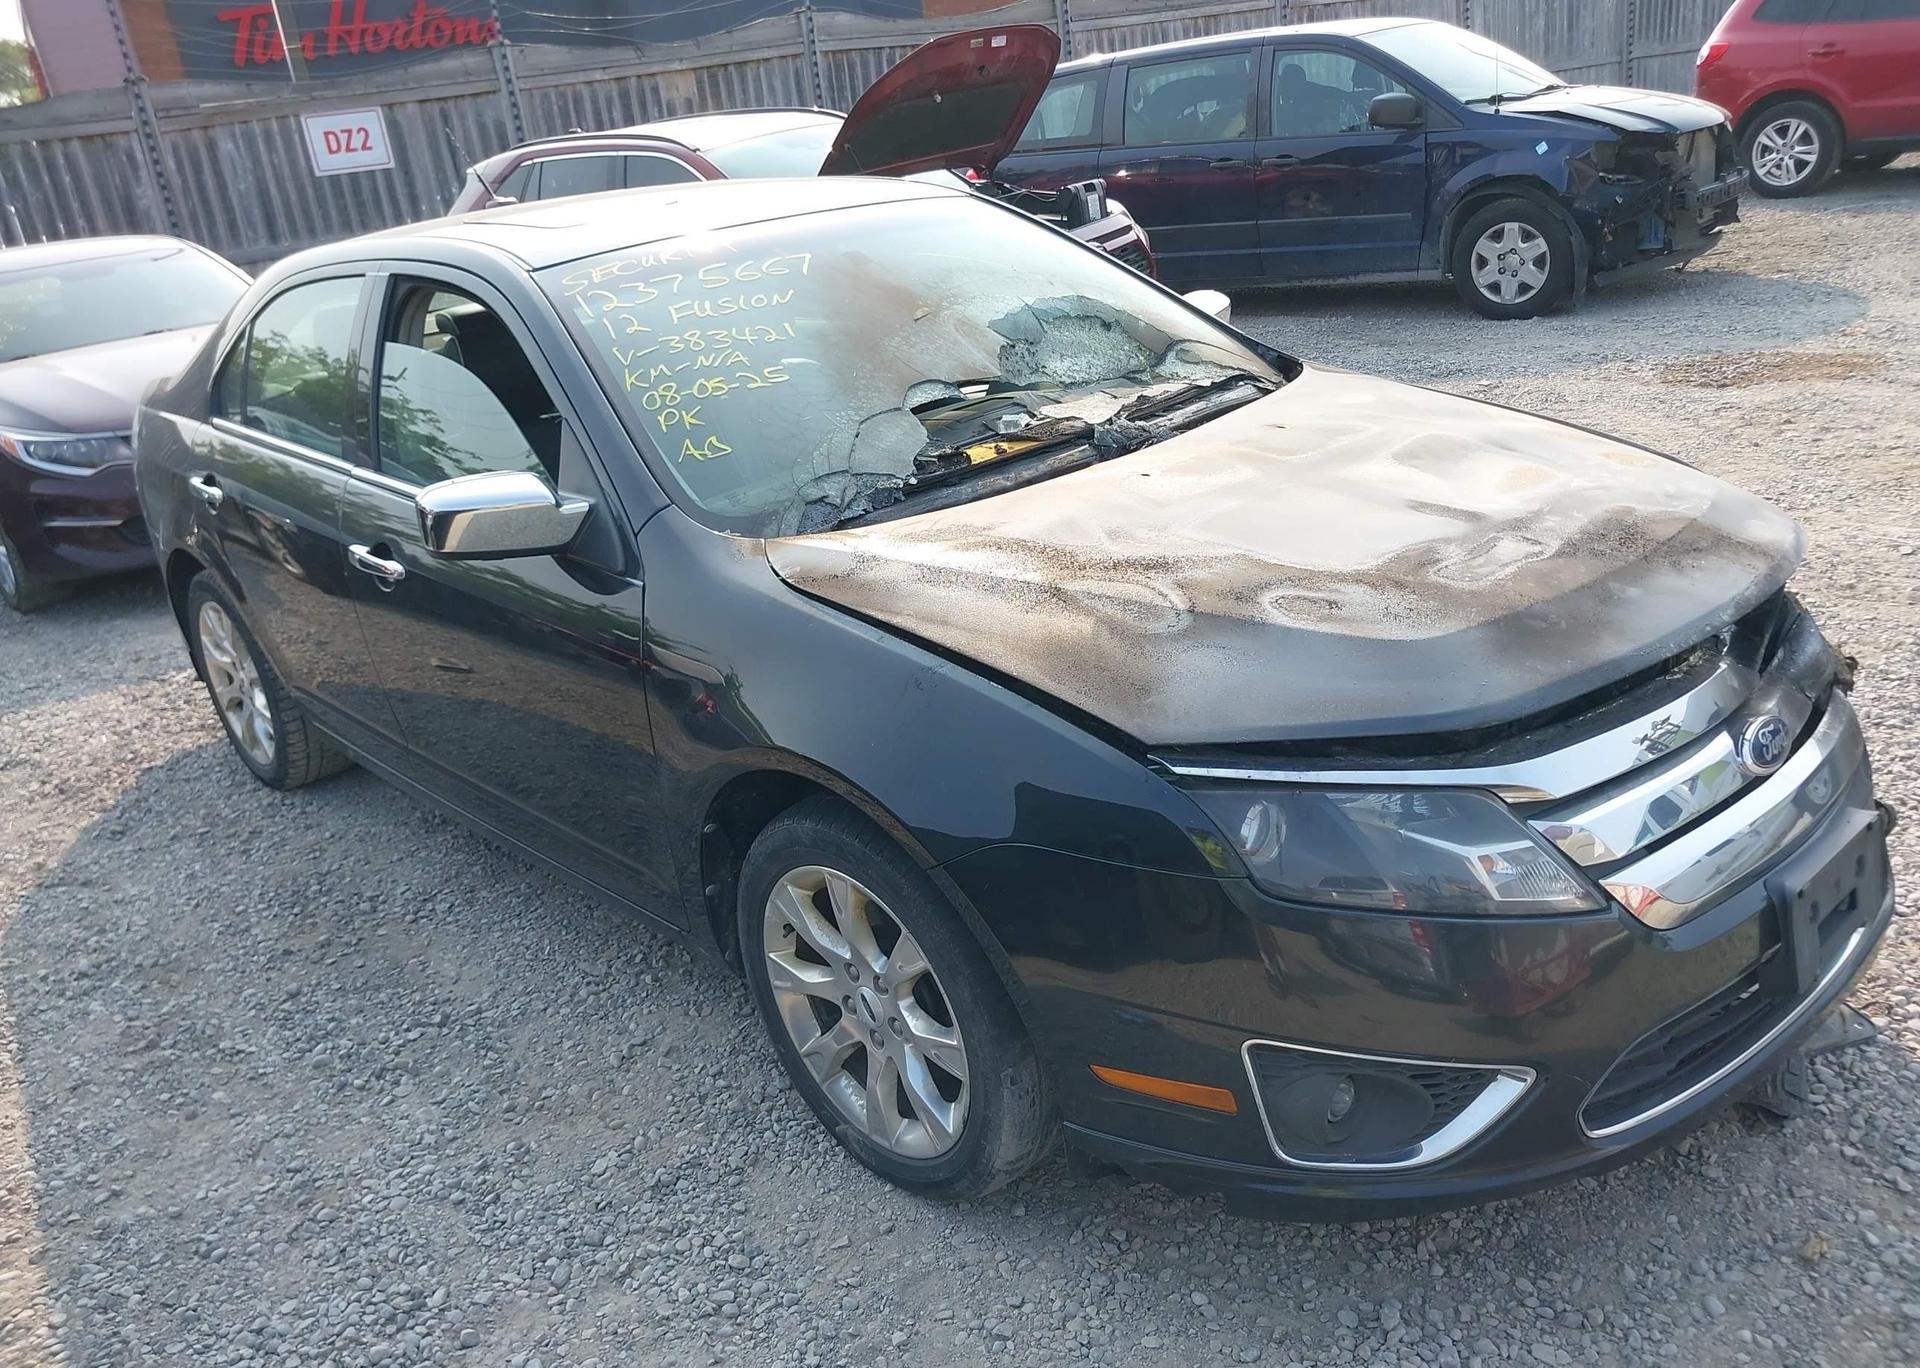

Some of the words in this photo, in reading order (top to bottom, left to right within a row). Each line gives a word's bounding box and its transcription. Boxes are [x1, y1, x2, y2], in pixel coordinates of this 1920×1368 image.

[323, 126, 374, 155] DZ2
[602, 314, 652, 340] 12
[668, 288, 795, 325] FUSION
[642, 365, 791, 411] 08-05-25
[657, 405, 706, 434] PK
[1758, 723, 1787, 761] Ford
